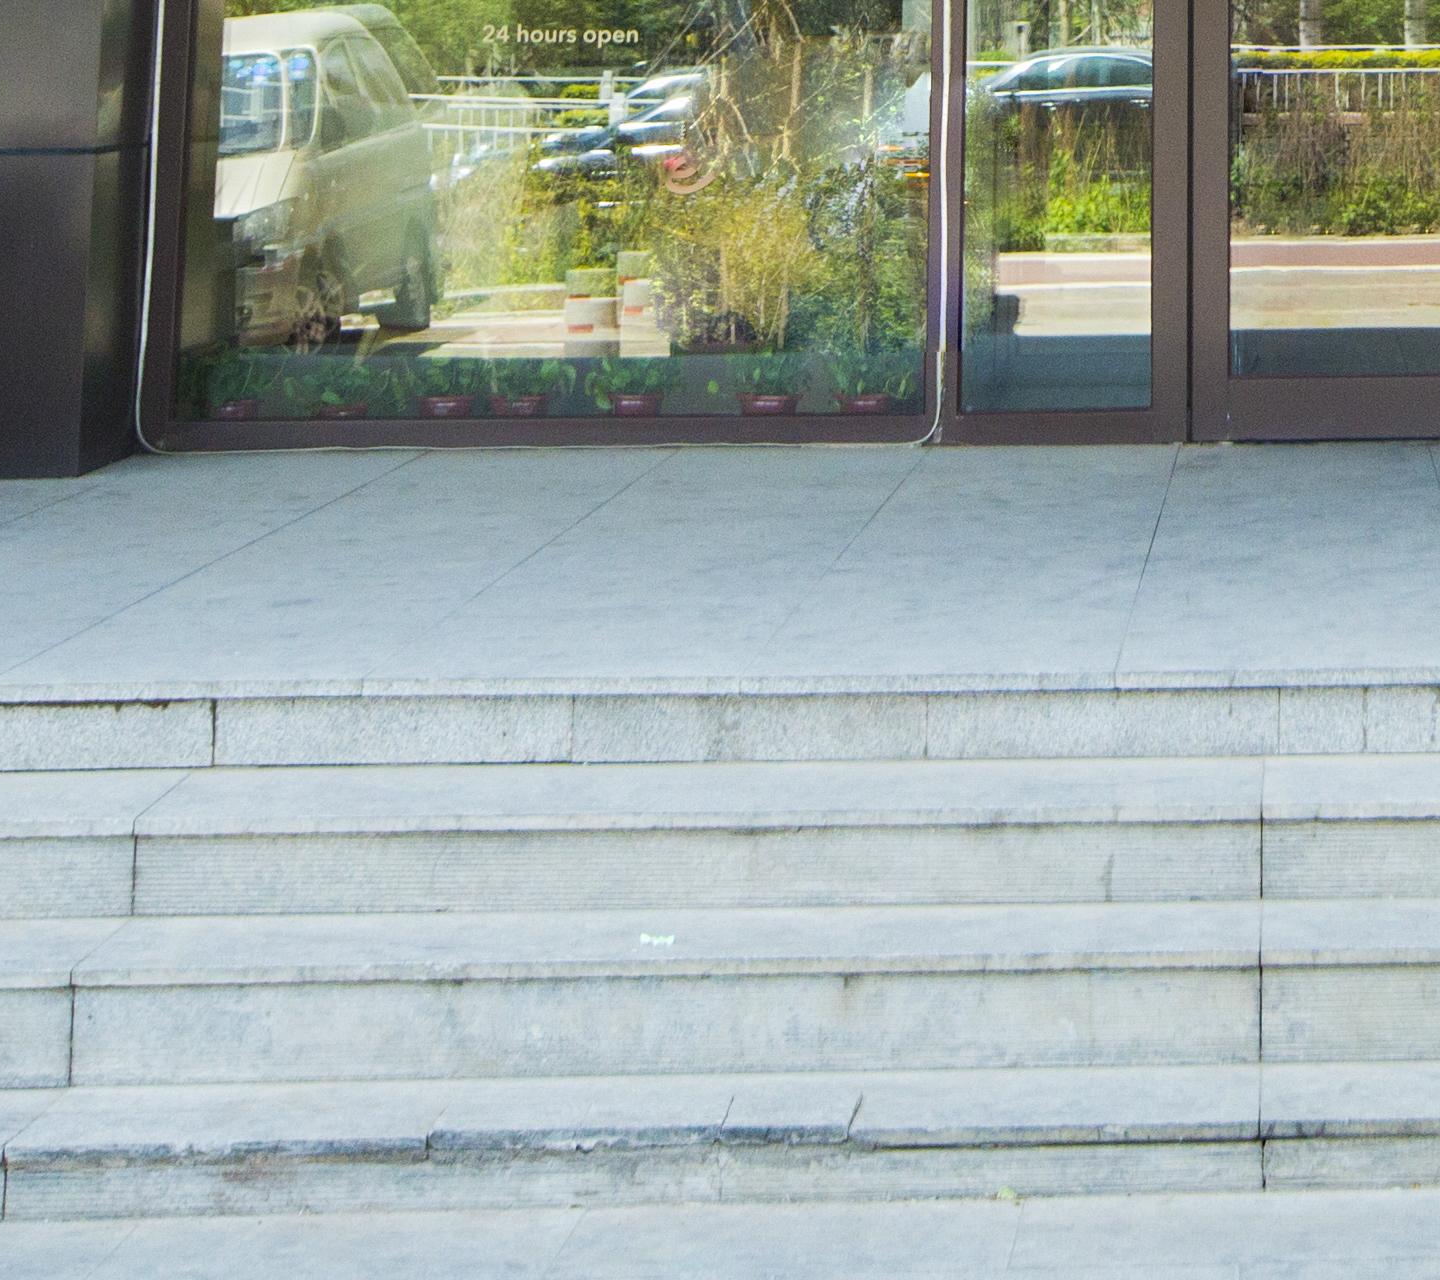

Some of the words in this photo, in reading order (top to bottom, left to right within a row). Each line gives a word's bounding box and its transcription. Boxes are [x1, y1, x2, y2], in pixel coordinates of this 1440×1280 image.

[482, 24, 510, 45] 24
[516, 24, 577, 45] hours
[582, 28, 639, 49] open
